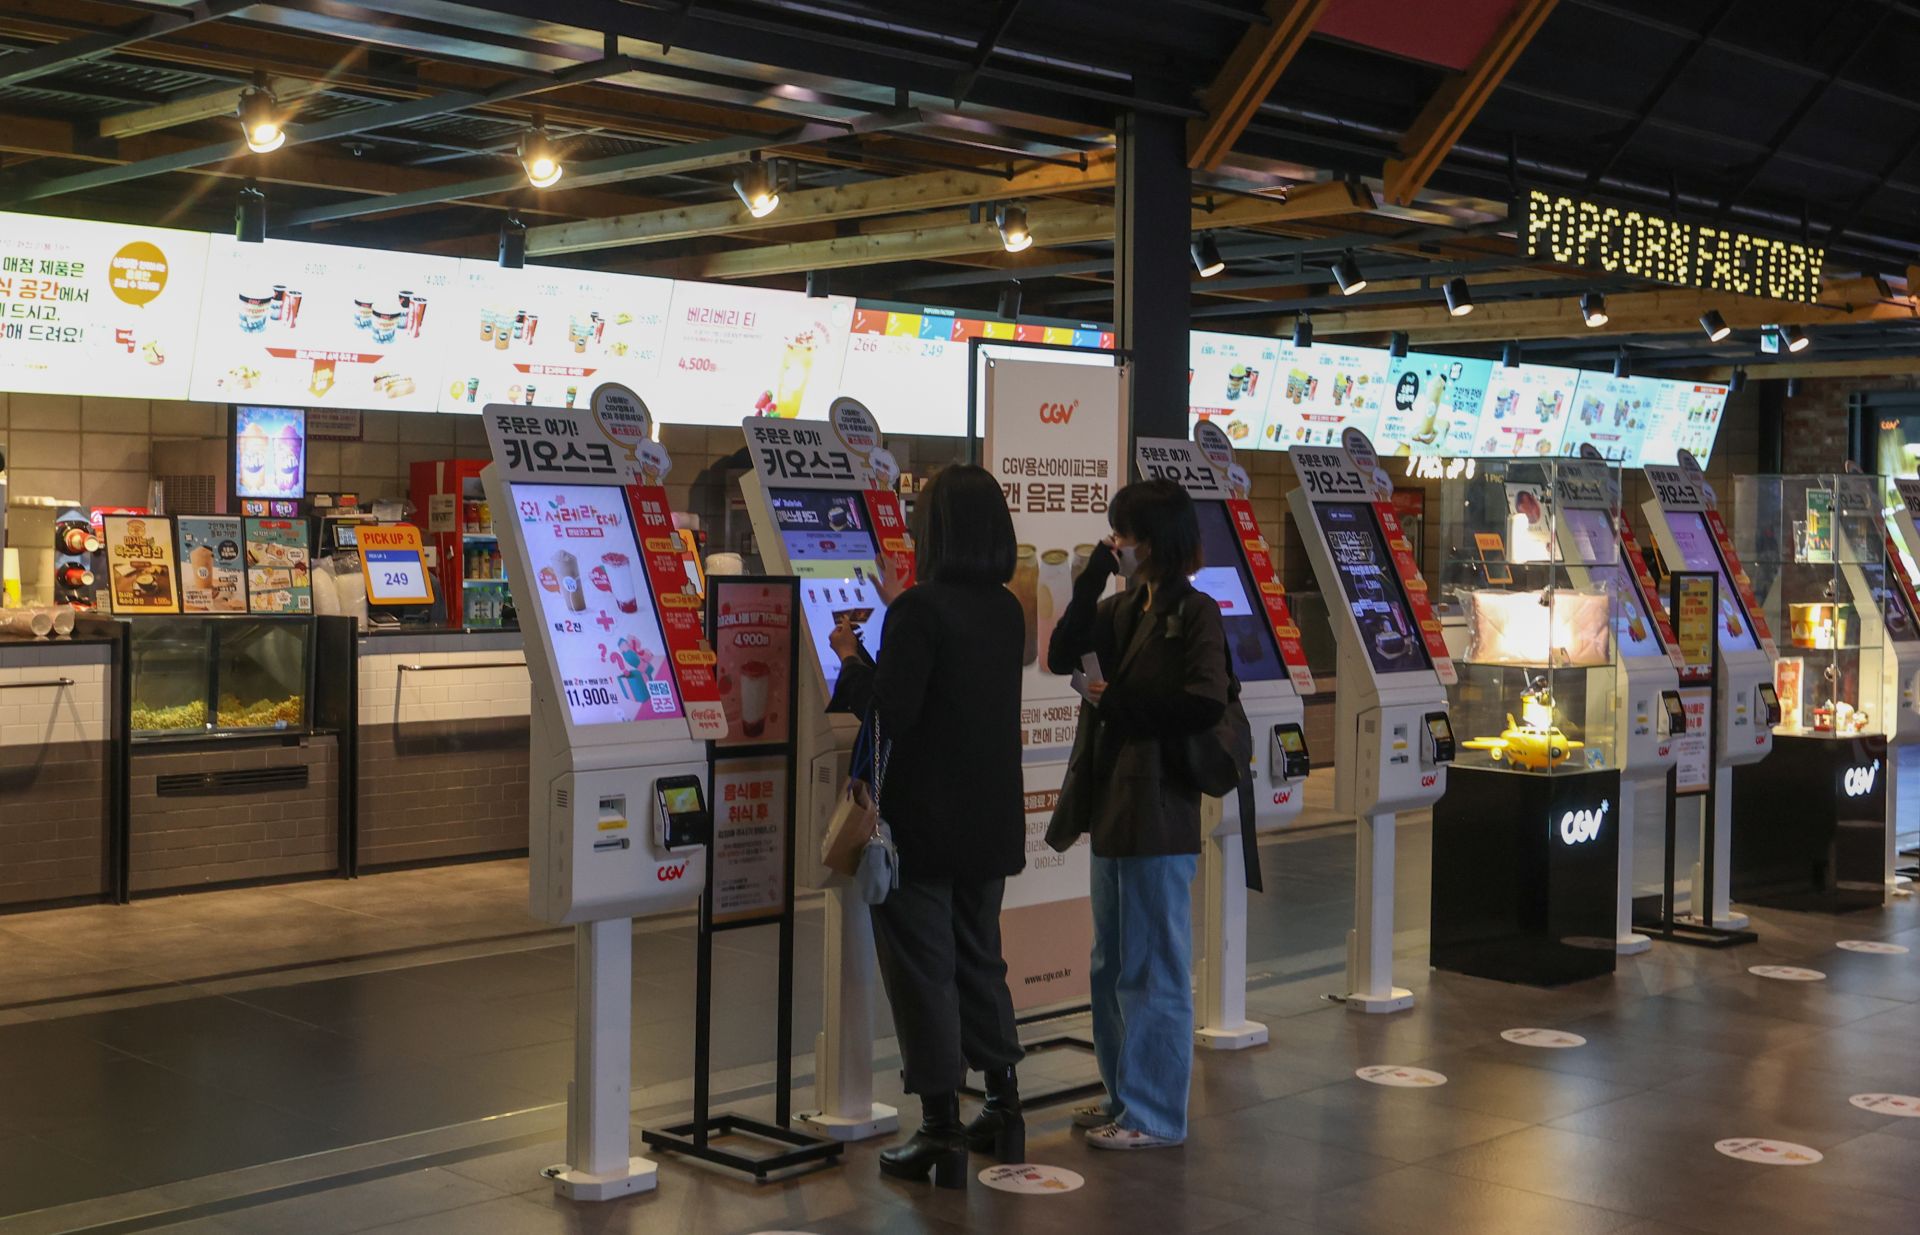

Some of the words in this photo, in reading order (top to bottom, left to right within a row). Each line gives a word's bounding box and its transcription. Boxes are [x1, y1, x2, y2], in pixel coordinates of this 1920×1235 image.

[1528, 190, 1690, 284] POPCORN
[1696, 226, 1824, 303] FACTORY
[3, 256, 34, 274] 매점
[39, 259, 85, 278] 제품은
[19, 279, 89, 303] 공간에서
[687, 306, 740, 327] 베리베리
[744, 311, 757, 327] 티
[28, 325, 83, 343] 드려요!
[921, 343, 943, 357] 249
[1040, 402, 1073, 424] CGV
[497, 415, 542, 436] 주문은
[545, 418, 579, 438] 여기!
[754, 427, 791, 445] 주문은
[794, 430, 822, 447] 여기!
[504, 439, 617, 474] 키오스크
[761, 448, 855, 480] 키오스크
[1140, 447, 1168, 462] 주문은
[1169, 449, 1192, 463] 여기!
[1297, 453, 1321, 466] 주문은
[1322, 455, 1340, 468] 여기!
[1002, 457, 1109, 478] CGV용산아이파크몰
[1651, 471, 1667, 483] 주문은
[1147, 465, 1219, 491] 키오스크
[1304, 470, 1366, 495] 키오스크
[1003, 483, 1021, 513] 캔
[1027, 482, 1066, 513] 음료
[1070, 482, 1108, 513] 론칭
[1657, 485, 1700, 504] 키오스크
[643, 513, 667, 527] TIP!
[879, 516, 899, 527] TIP!
[364, 533, 389, 545] PICK
[390, 532, 404, 544] UP
[407, 533, 415, 545] 3
[384, 572, 409, 586] 249
[567, 687, 618, 707] 11,900원
[1043, 705, 1072, 722] +500원
[1032, 728, 1052, 744] 캔에
[1755, 736, 1765, 745] CGV
[1658, 746, 1670, 756] CGV
[724, 780, 774, 801] 음식물은
[1421, 776, 1438, 787] CGV
[1844, 766, 1877, 797] CGV
[1273, 792, 1291, 804] CGV
[728, 804, 753, 822] 취식
[756, 803, 769, 821] 후
[1560, 808, 1603, 845] CGV
[1034, 855, 1065, 870] 아이스티
[657, 865, 686, 882] CGV
[1024, 968, 1072, 985] www.cgv.co.kr
